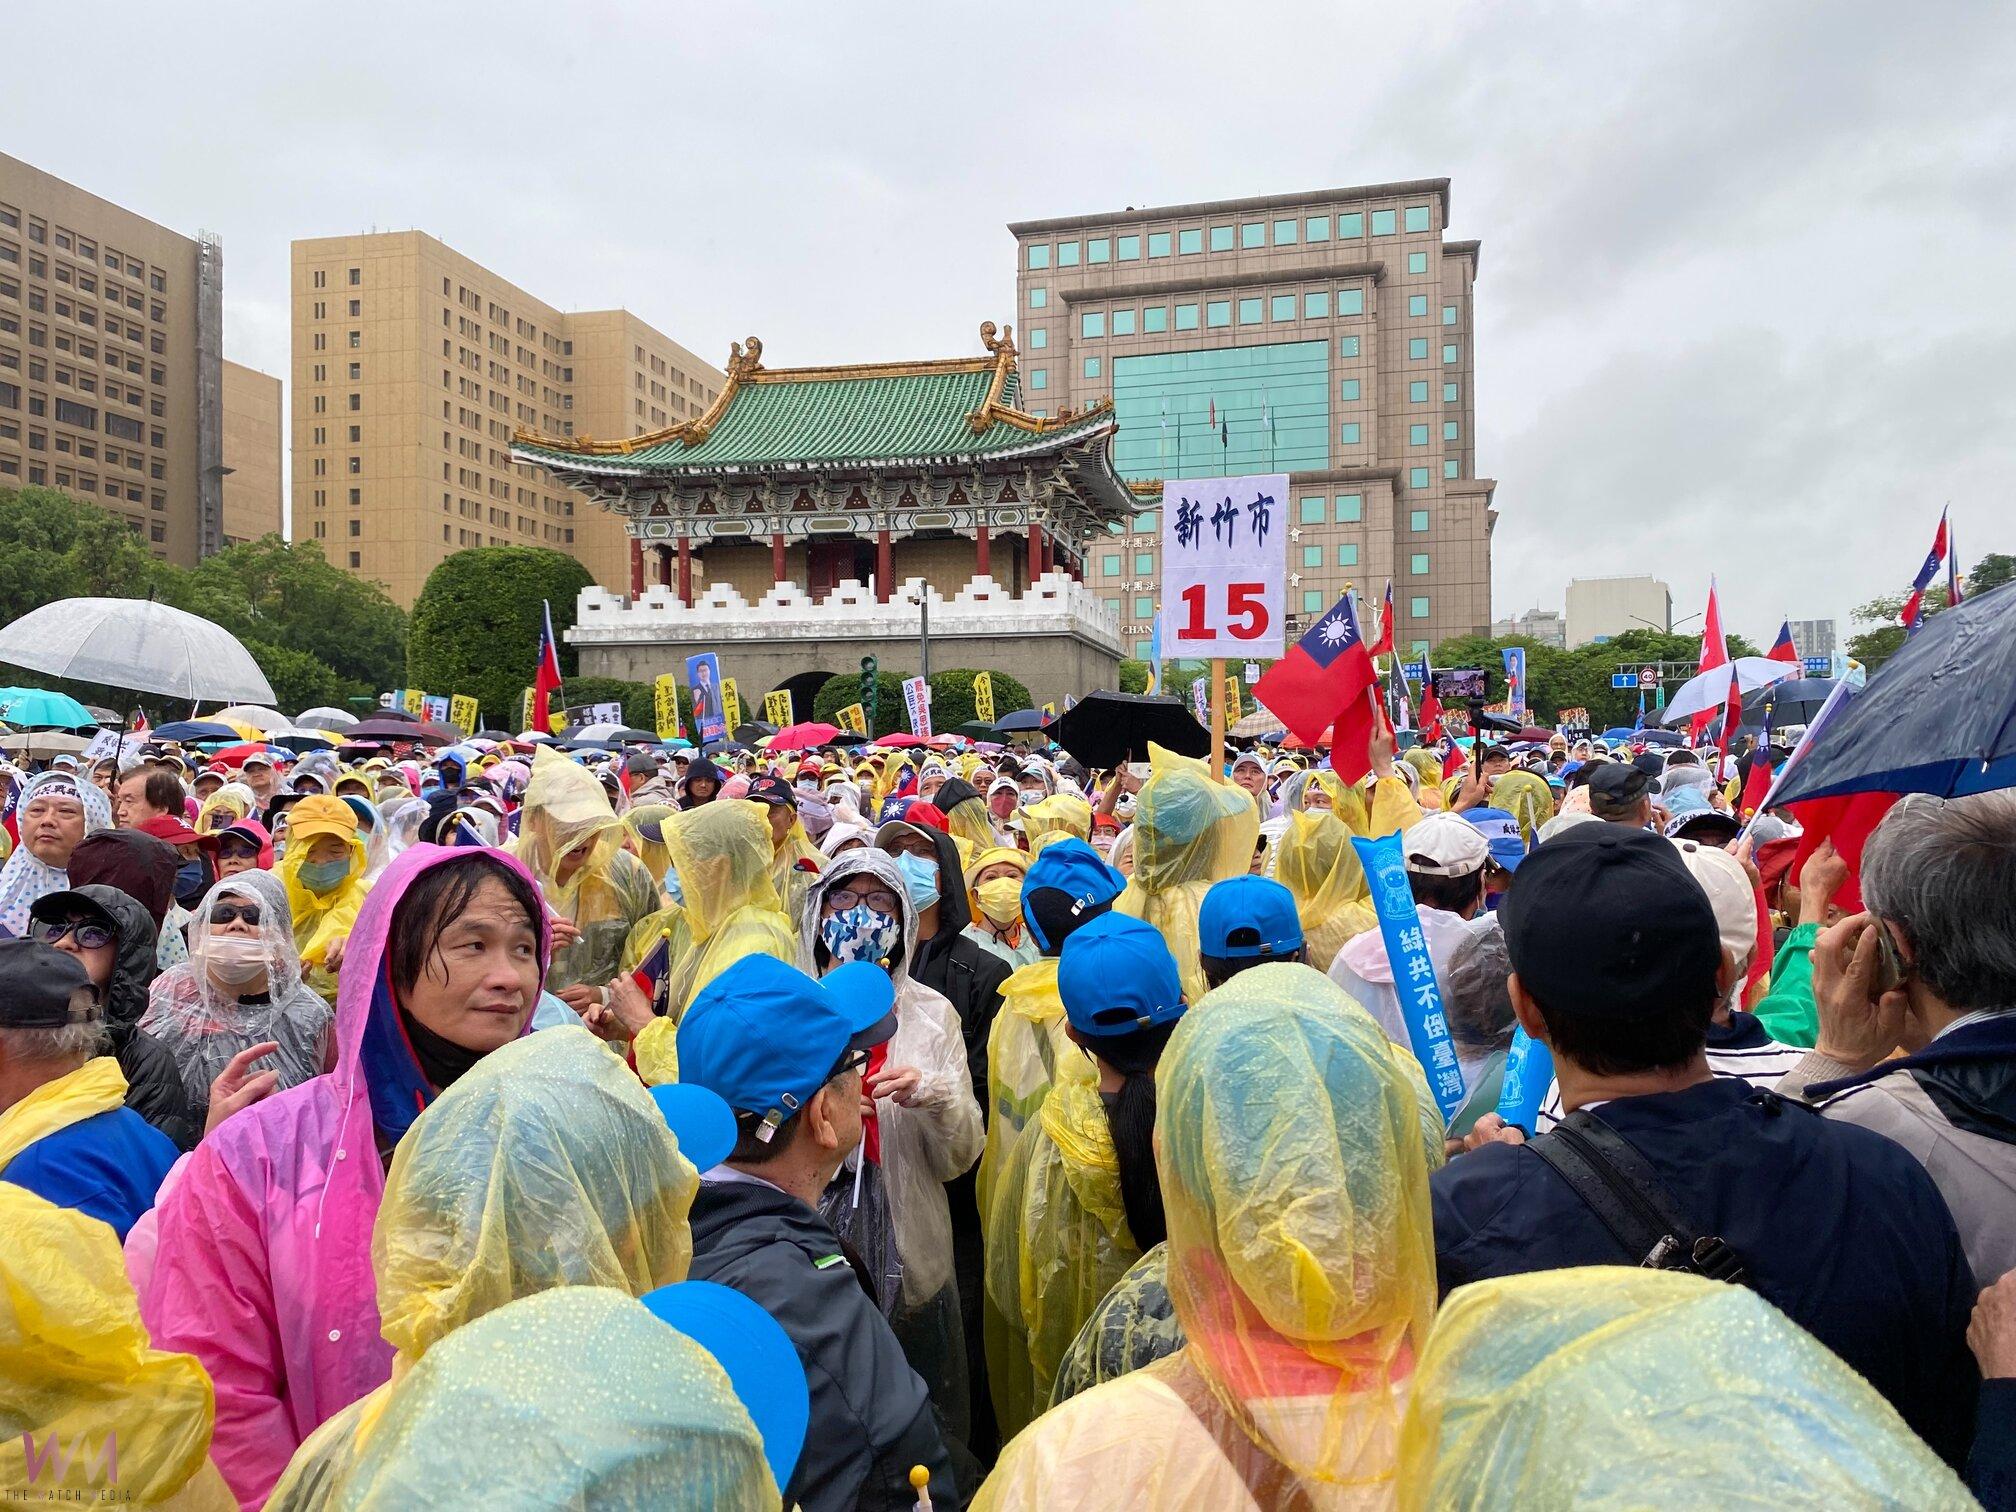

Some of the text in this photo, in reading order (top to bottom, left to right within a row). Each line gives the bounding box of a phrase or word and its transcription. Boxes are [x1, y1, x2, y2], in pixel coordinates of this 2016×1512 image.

[1174, 491, 1275, 550] 新竹市
[1177, 583, 1269, 640] 15
